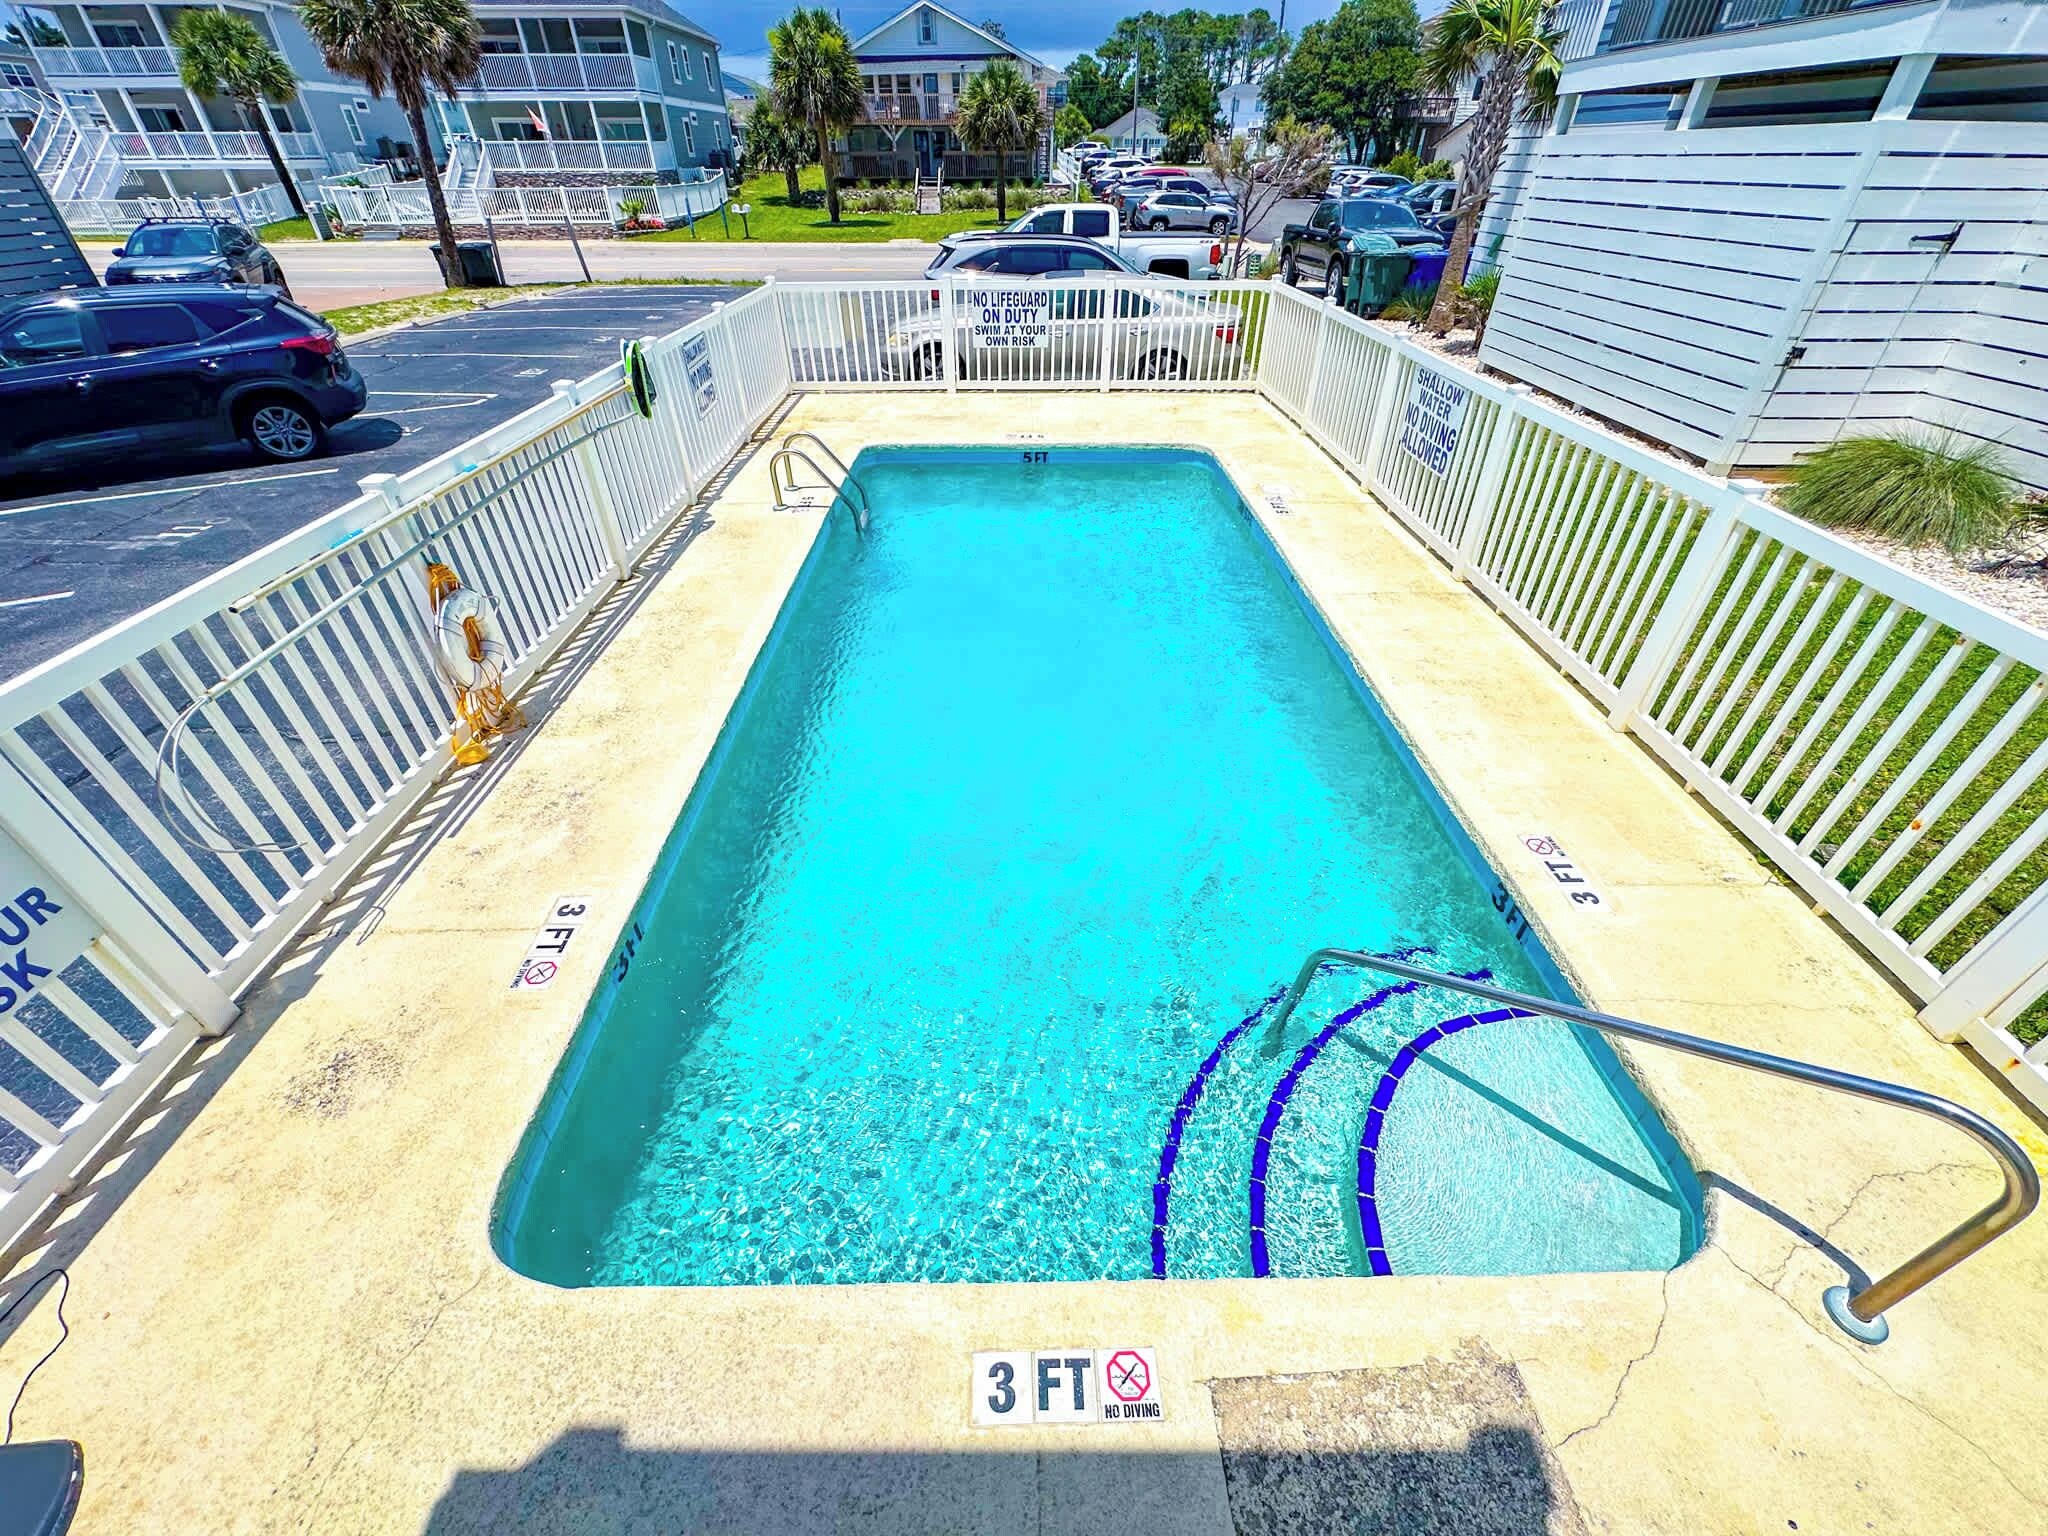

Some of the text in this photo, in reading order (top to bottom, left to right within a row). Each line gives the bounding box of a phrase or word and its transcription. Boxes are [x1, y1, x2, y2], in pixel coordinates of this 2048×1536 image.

[973, 291, 1047, 308] NO LIFEGUARD
[983, 308, 1038, 323] ON DUTY
[975, 325, 1046, 335] SWIM AT YOUR
[985, 336, 1035, 346] OWN RISK
[1418, 368, 1464, 406] SHALLOW
[1419, 387, 1452, 422] WATER
[1405, 401, 1457, 452] NO DIVING
[1023, 451, 1048, 464] 5 FT
[1401, 425, 1448, 475] ALLOWED
[1544, 861, 1584, 882] FT
[1571, 892, 1599, 905] 3
[536, 904, 586, 953] 3 FT
[988, 1358, 1091, 1413] 3 FT
[1105, 1403, 1160, 1419] NO DIVING
